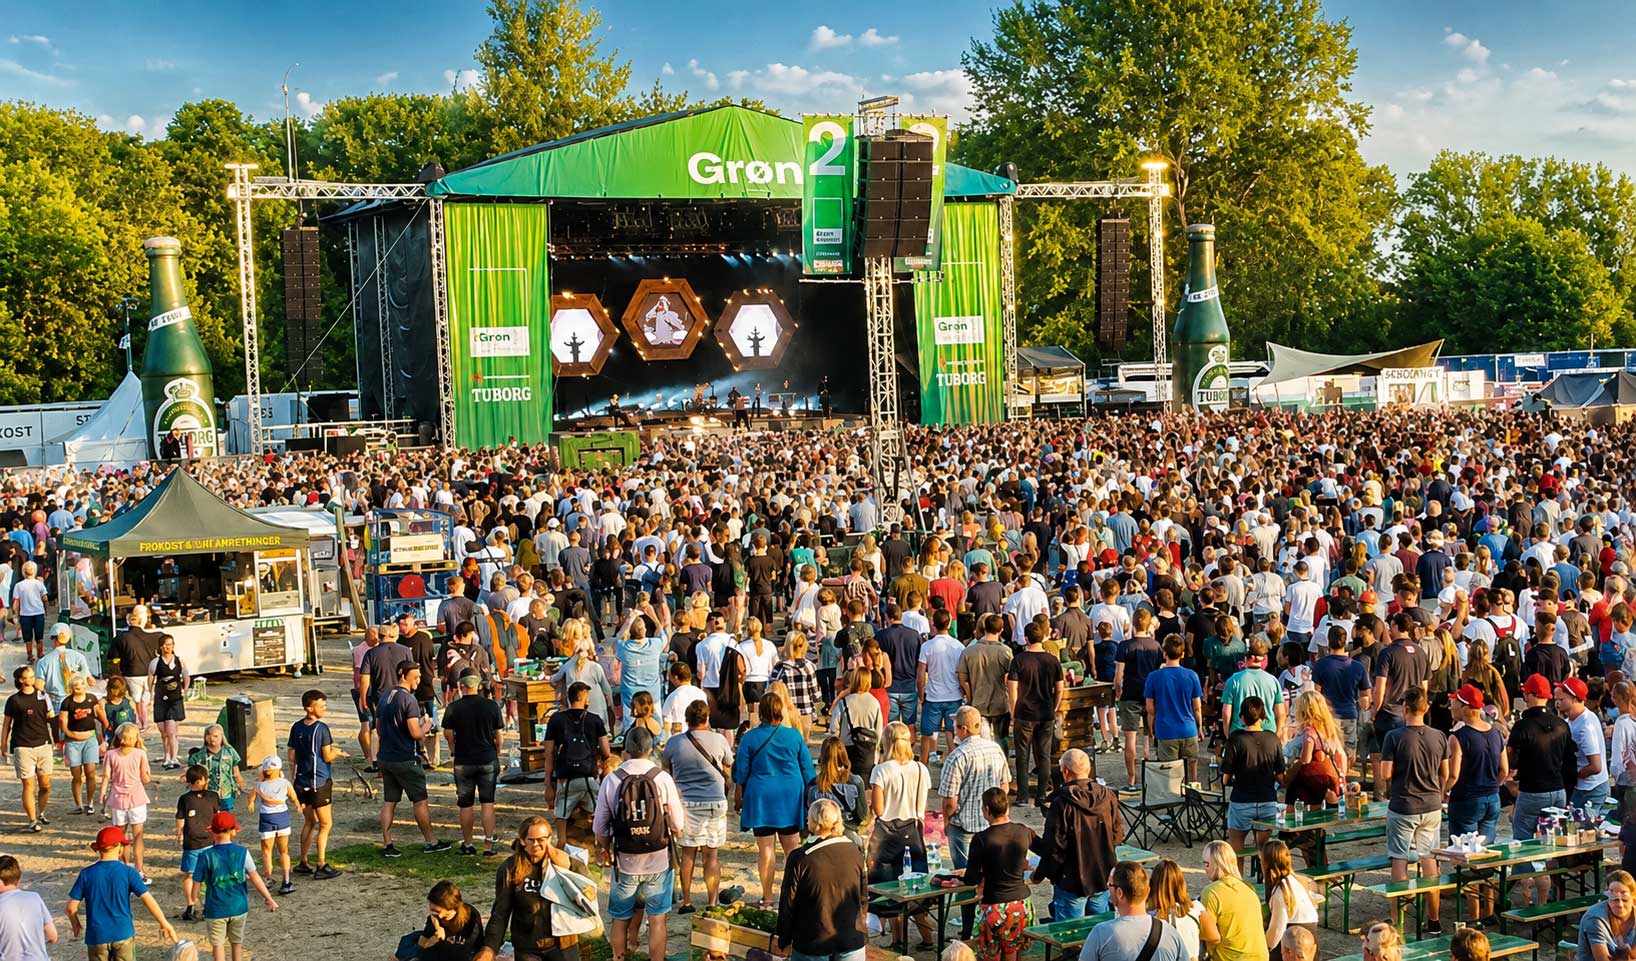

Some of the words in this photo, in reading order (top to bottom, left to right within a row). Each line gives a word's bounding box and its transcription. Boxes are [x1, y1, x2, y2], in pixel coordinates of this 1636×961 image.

[809, 121, 846, 176] 2
[688, 152, 804, 184] Grøn
[936, 371, 986, 386] TUBORG
[471, 387, 531, 402] TUBORG
